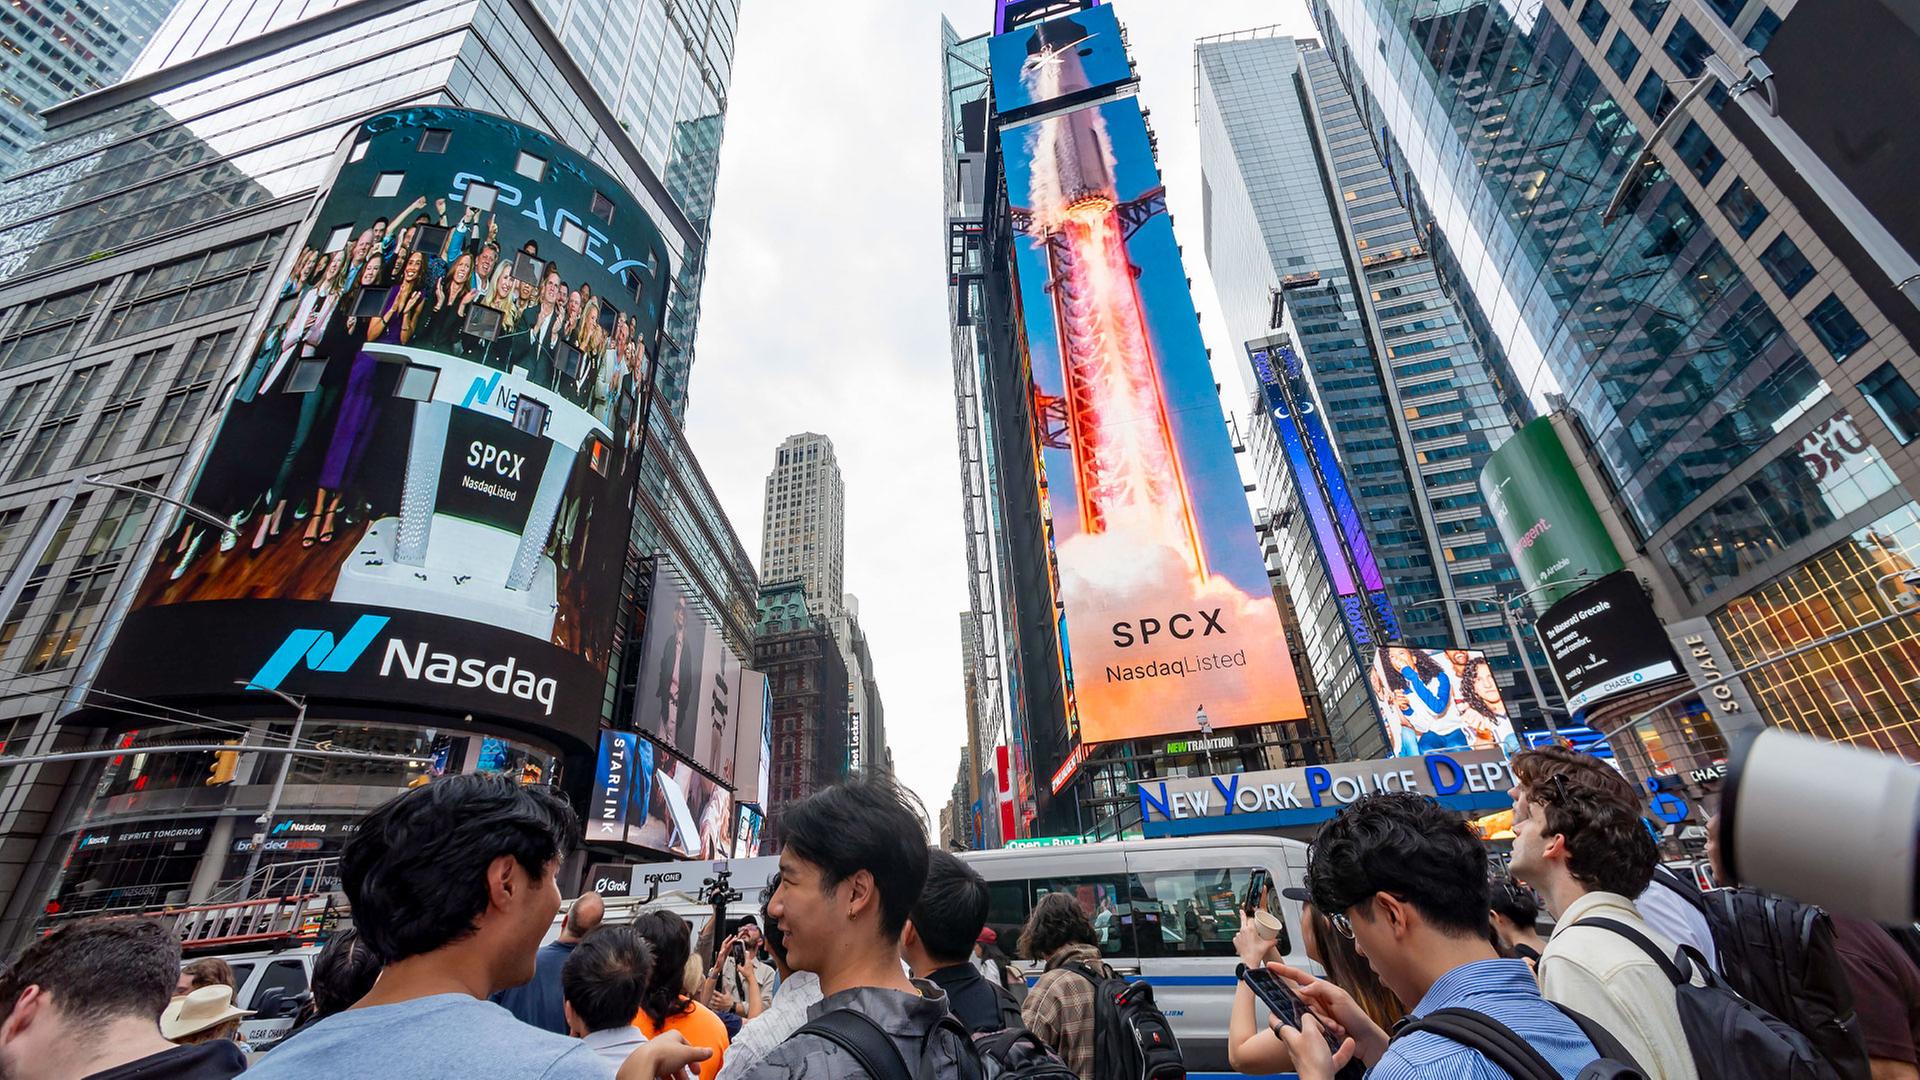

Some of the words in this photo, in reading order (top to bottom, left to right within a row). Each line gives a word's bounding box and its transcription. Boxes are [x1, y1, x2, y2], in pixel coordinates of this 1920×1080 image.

[496, 385, 553, 431] Naq
[467, 440, 525, 481] SPCX
[462, 475, 517, 501] NasdaqListed
[1343, 597, 1371, 644] ROKU
[1578, 601, 1611, 620] Grecale
[1112, 608, 1227, 648] SPCX
[379, 638, 558, 716] Nasdaq
[1106, 650, 1247, 682] NasdaqListed
[1684, 634, 1740, 714] SQUARE
[1603, 675, 1633, 692] CHASE
[850, 714, 859, 747] Locker
[600, 737, 625, 833] STARLINK
[1690, 766, 1728, 782] CHAS
[1138, 782, 1210, 822] NEW
[1212, 775, 1303, 815] YORK
[290, 823, 326, 832] Nasdaq
[607, 881, 627, 891] Grok
[249, 1029, 267, 1039] CLEAR
